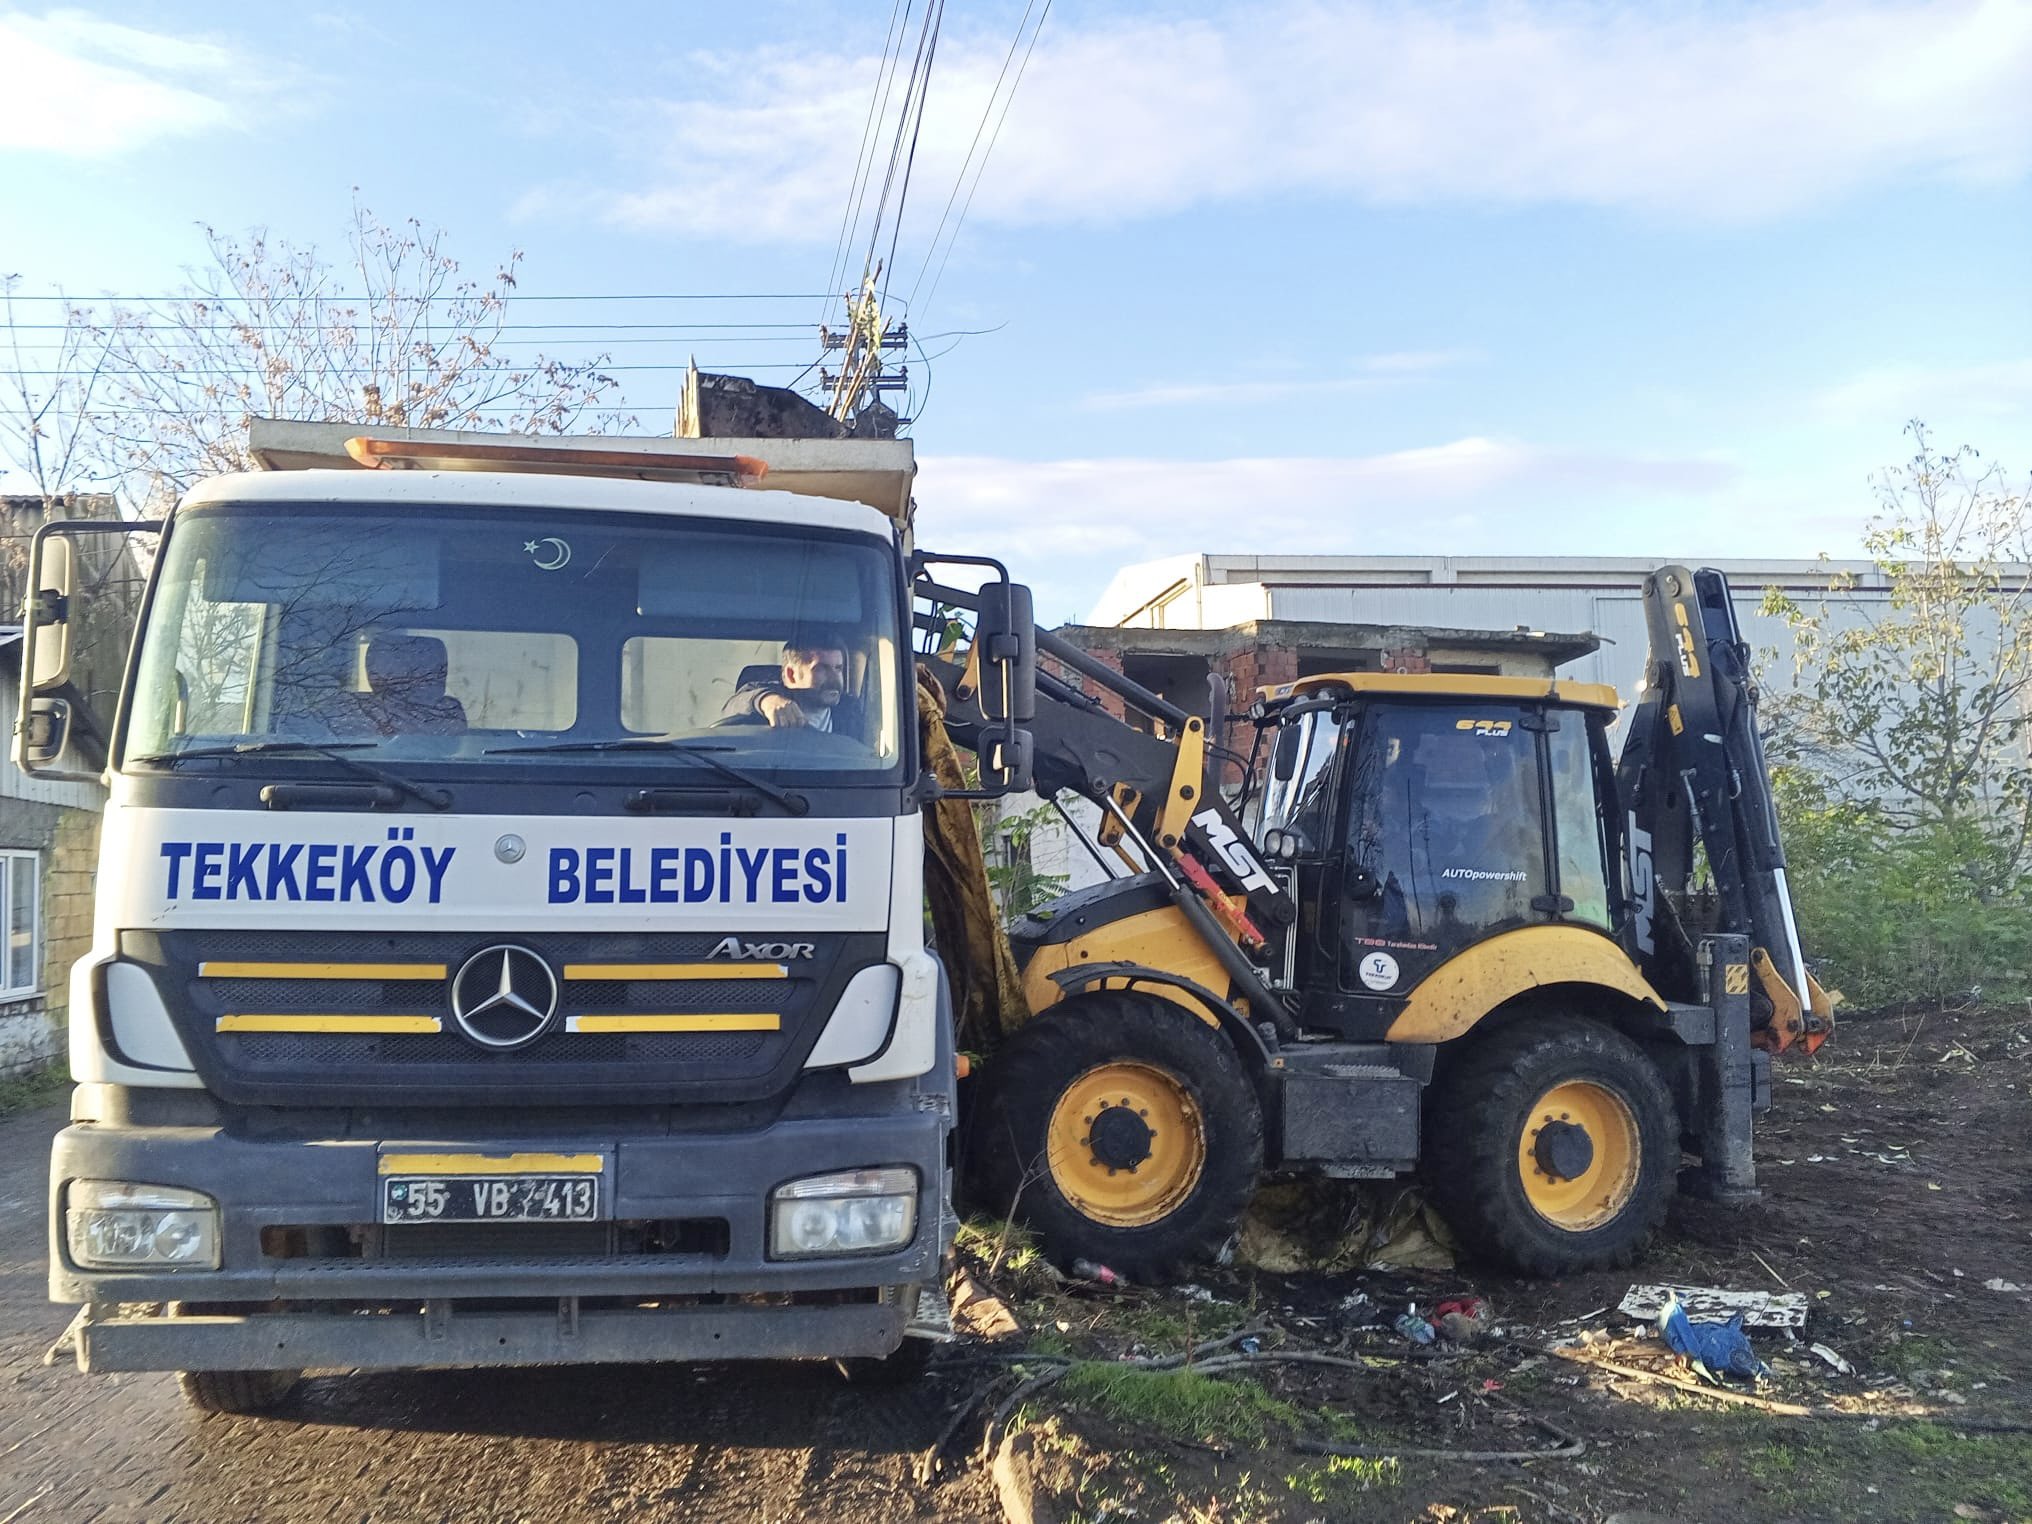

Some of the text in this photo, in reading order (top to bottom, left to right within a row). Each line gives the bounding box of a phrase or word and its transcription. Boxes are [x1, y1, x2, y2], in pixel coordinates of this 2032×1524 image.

[159, 826, 848, 904] TEKKEKÖY BELEDİYESİ
[1190, 807, 1280, 895] MST
[1441, 868, 1528, 882] AUTOpowershift
[1627, 809, 1655, 956] MST
[407, 1182, 446, 1217] 55
[472, 1183, 509, 1217] VB
